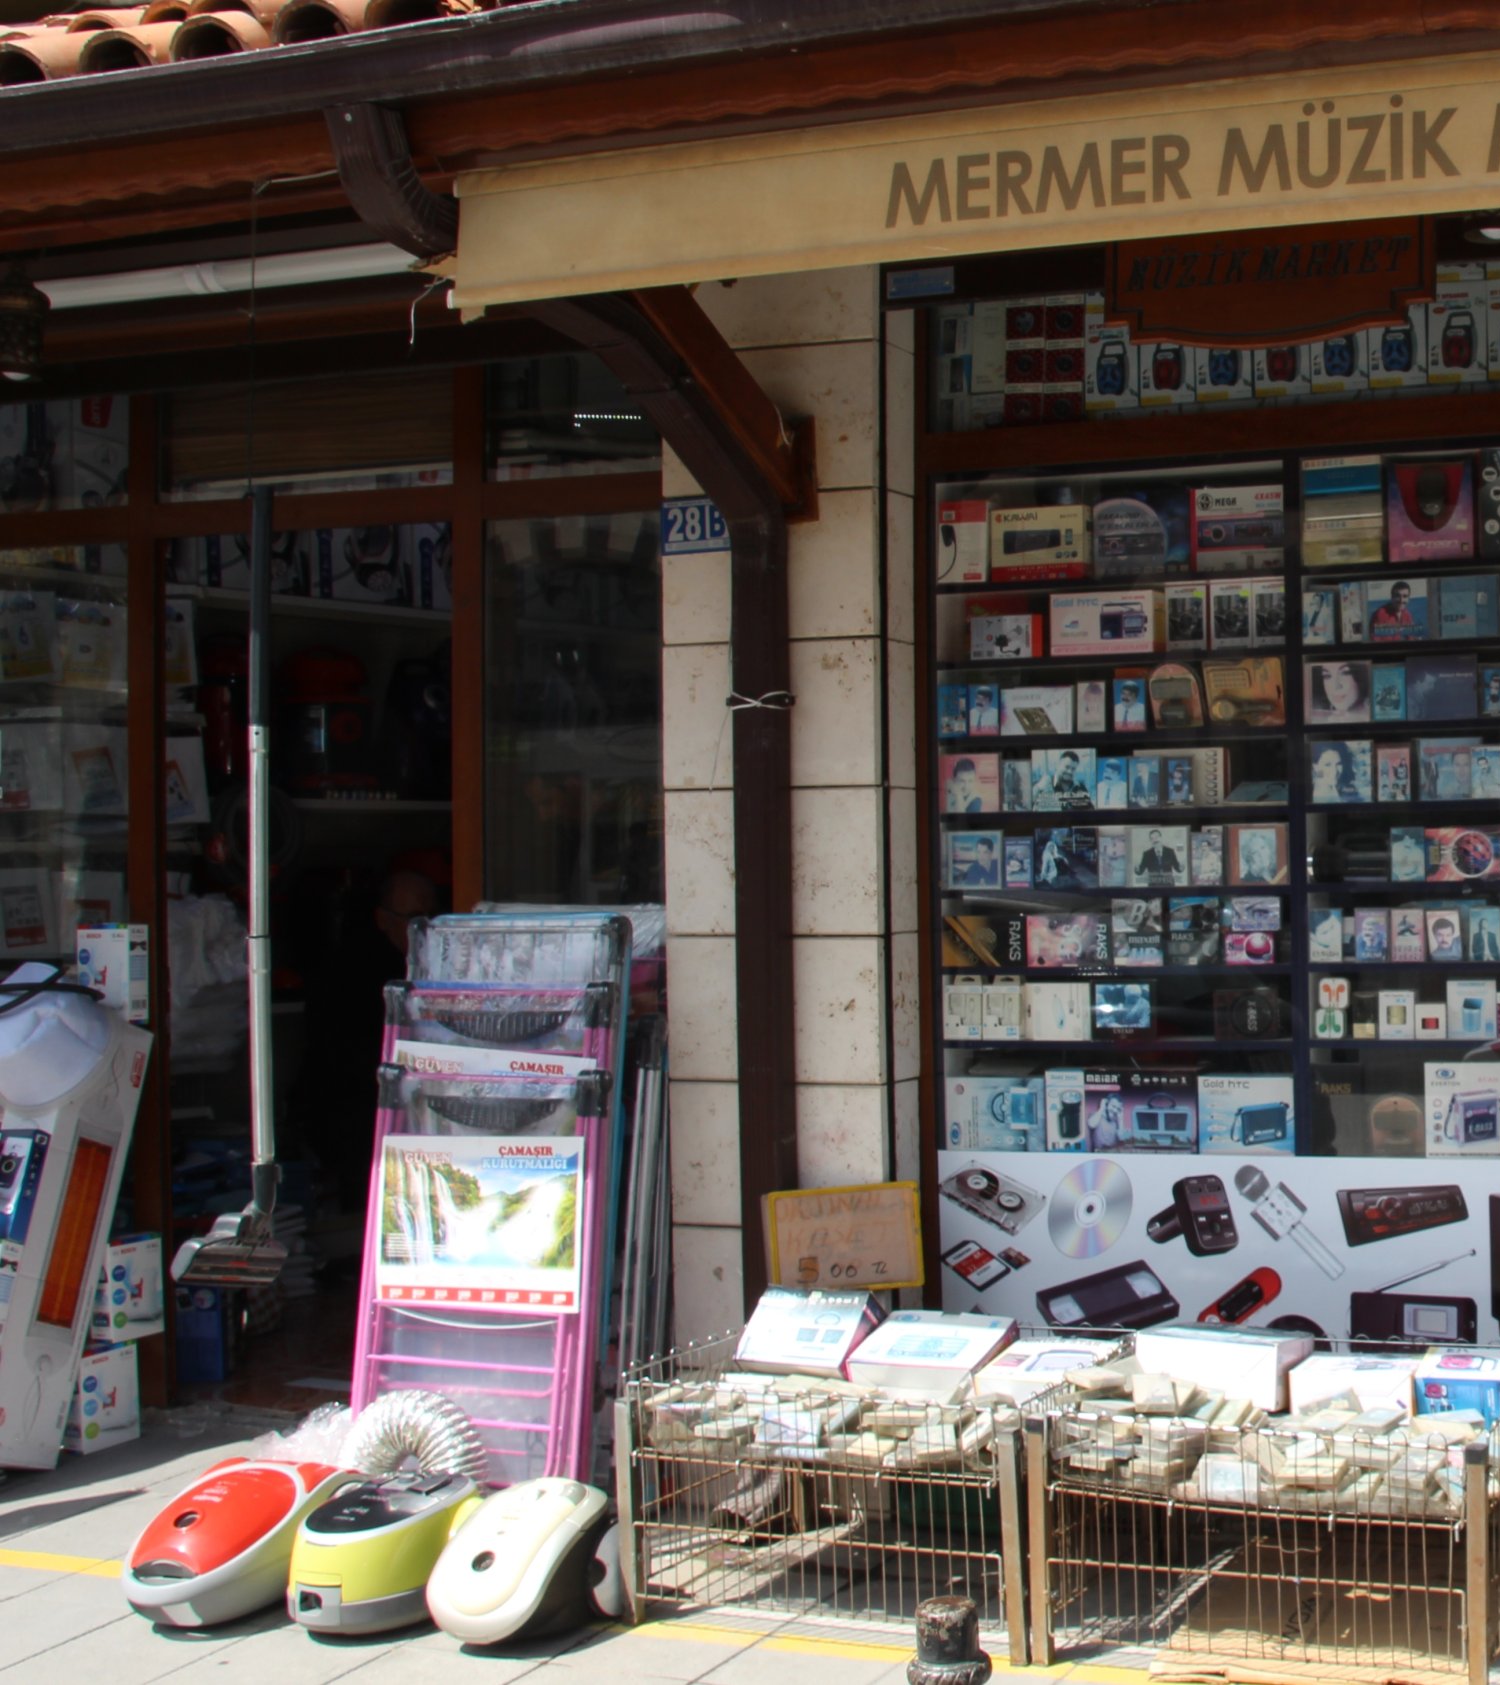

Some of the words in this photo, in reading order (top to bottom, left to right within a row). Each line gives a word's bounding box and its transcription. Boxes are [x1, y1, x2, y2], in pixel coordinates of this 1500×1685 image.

[885, 134, 1191, 229] MERMER
[1217, 94, 1460, 197] MÜZİK
[1127, 239, 1251, 292] MÜZİK
[1256, 235, 1412, 282] MARKET
[1009, 921, 1022, 962] RAKS
[1096, 923, 1108, 961] RAKS
[1171, 932, 1195, 941] RAKS
[509, 1060, 565, 1076] ÇAMAŞIR
[1202, 1079, 1225, 1088] Gold
[498, 1145, 554, 1158] ÇAMAŞIR
